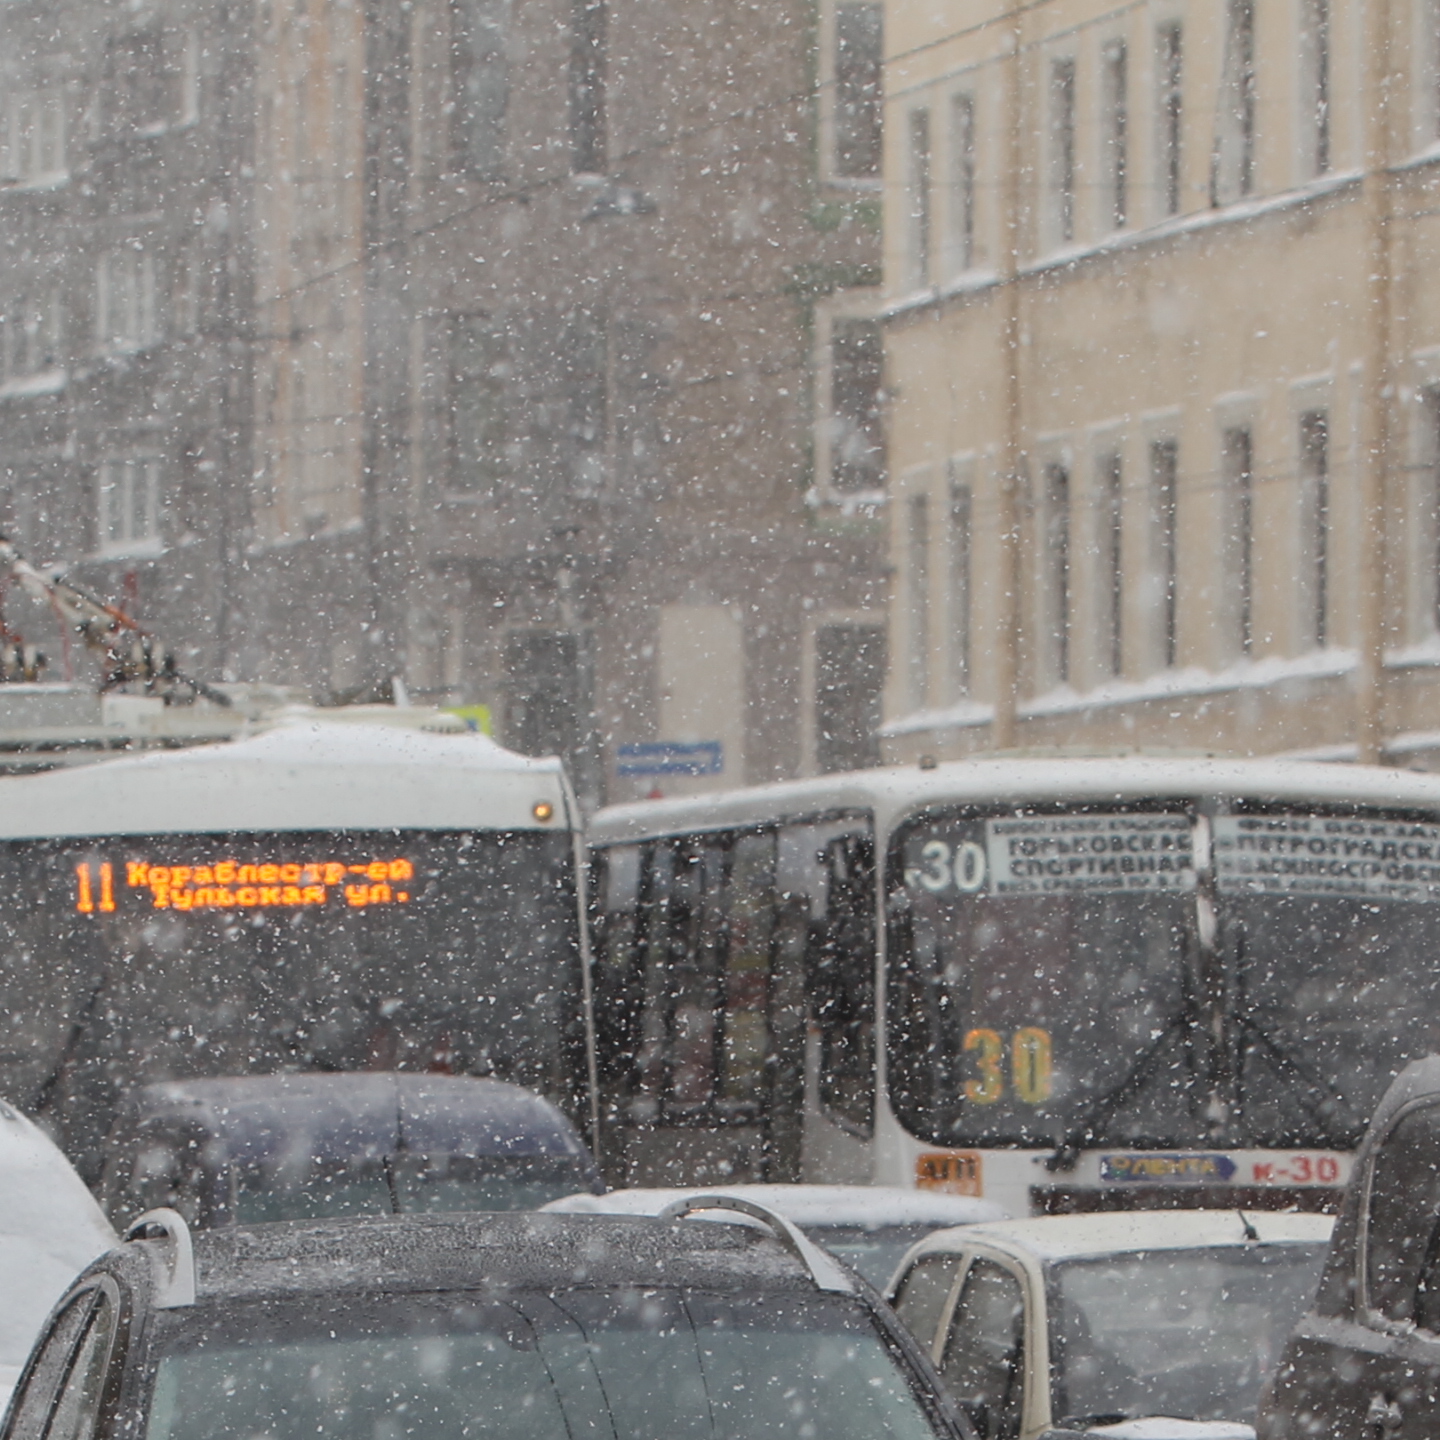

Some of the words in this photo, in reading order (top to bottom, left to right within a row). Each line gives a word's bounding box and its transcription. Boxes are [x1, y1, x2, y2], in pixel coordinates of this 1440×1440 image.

[1010, 855, 1192, 877] СПОРТИВНАЯ
[77, 861, 116, 912] 11
[151, 884, 326, 911] Тульская
[344, 884, 408, 906] ул.
[964, 1027, 1052, 1103] 30
[1131, 1157, 1218, 1175] ЛЕНТА
